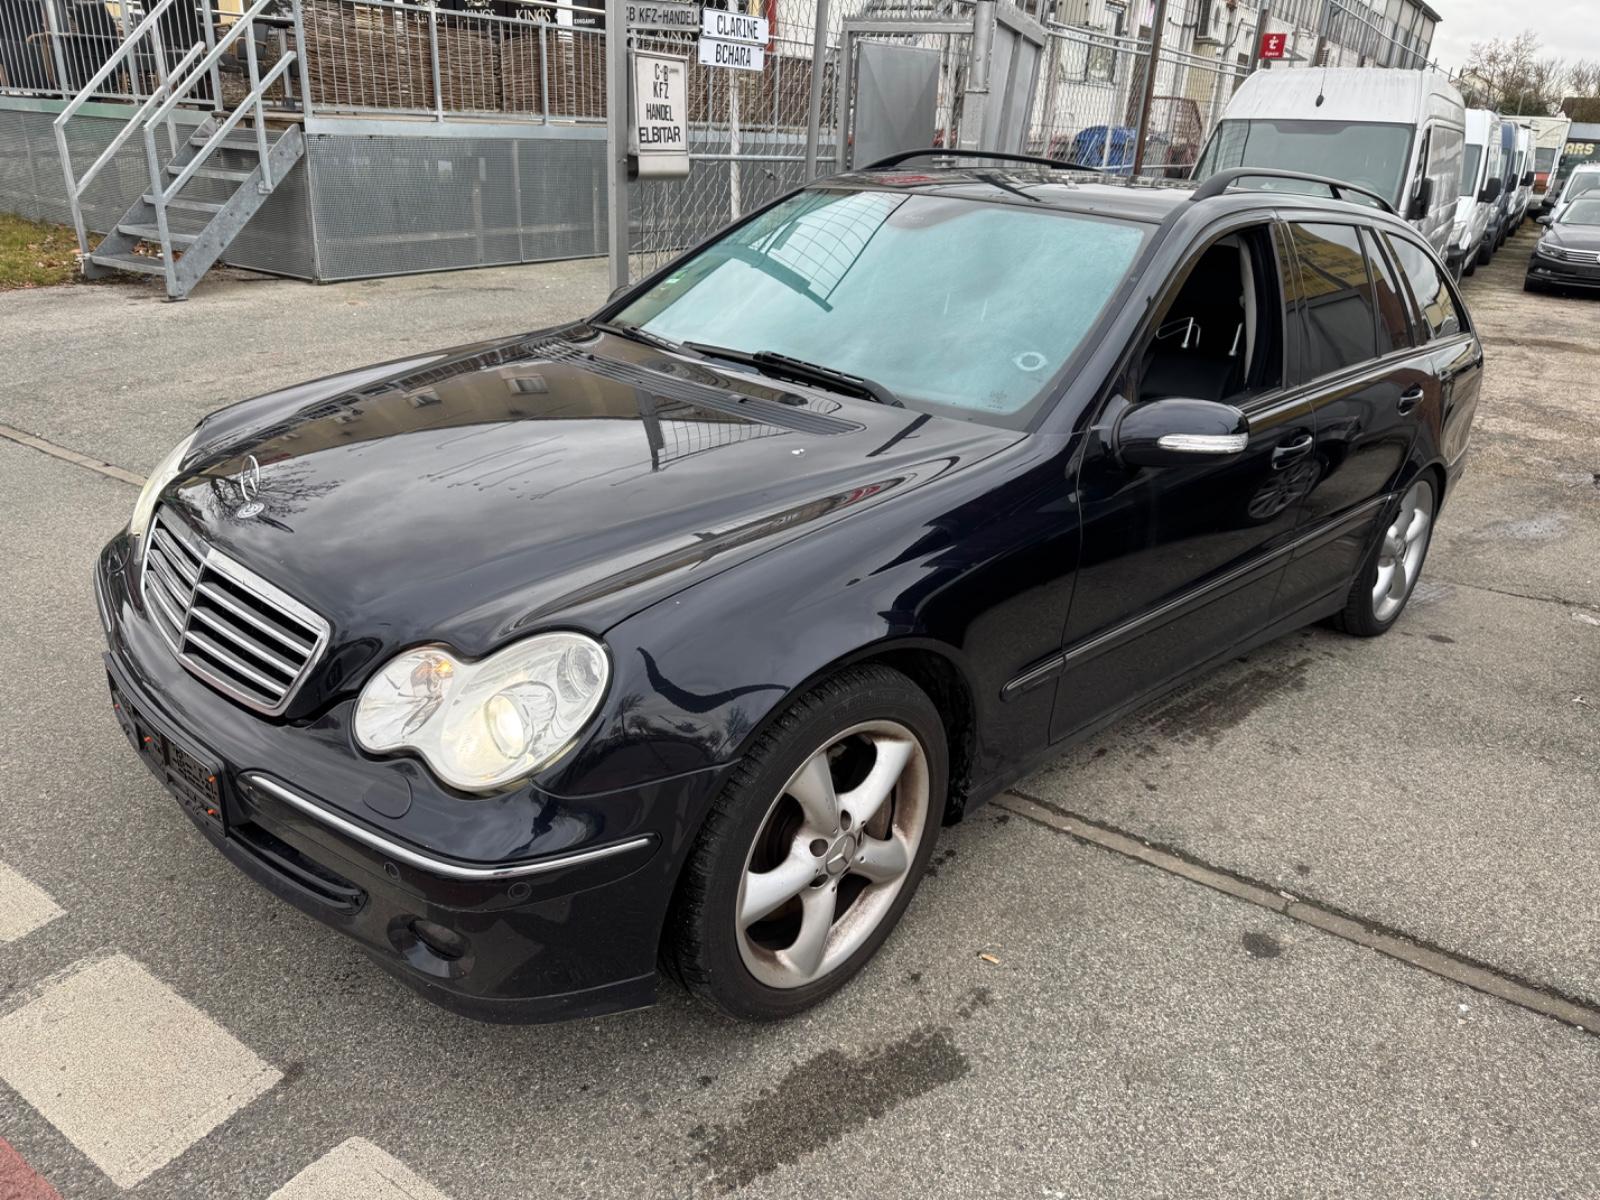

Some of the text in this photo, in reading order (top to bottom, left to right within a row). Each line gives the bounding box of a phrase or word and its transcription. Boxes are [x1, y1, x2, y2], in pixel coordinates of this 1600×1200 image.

[639, 7, 698, 26] KFZ-HANDEL
[716, 14, 760, 40] CLARINE
[715, 43, 751, 67] BCHARA
[653, 81, 669, 99] KFZ
[646, 103, 674, 122] HANDEL
[639, 126, 681, 144] ELBITAR
[1564, 142, 1595, 155] ARS
